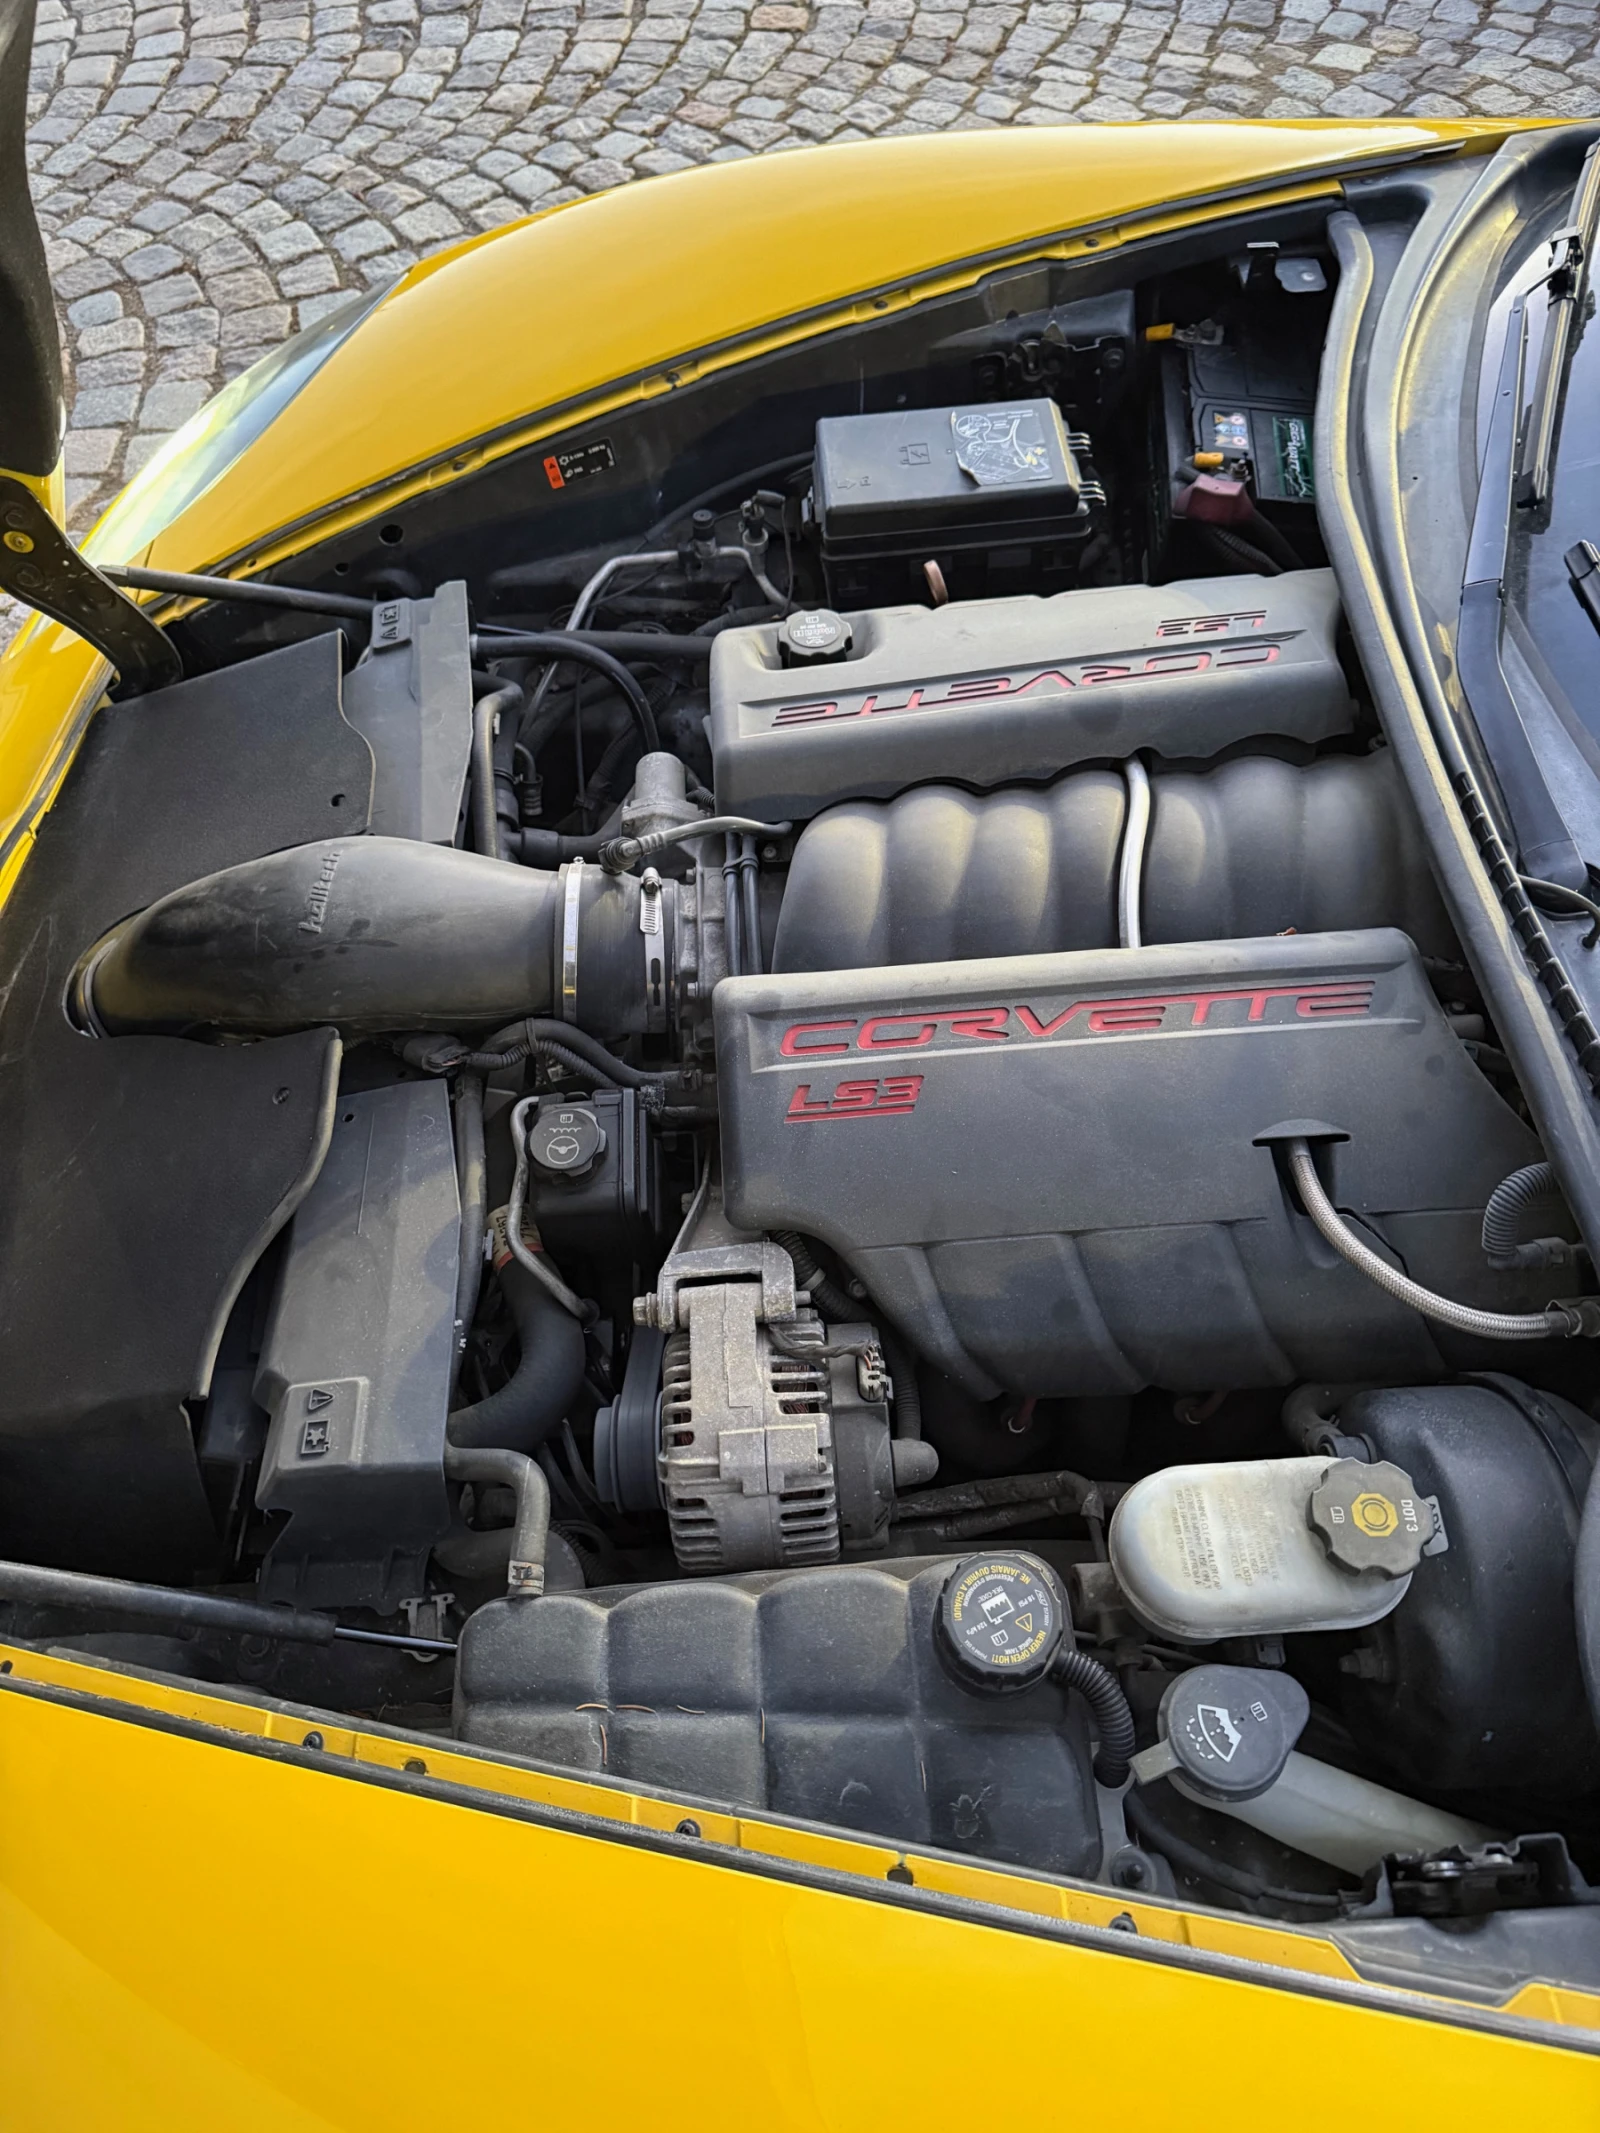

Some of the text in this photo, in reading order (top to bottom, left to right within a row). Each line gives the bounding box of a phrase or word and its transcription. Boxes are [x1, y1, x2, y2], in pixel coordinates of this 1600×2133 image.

[1156, 611, 1267, 637] LS3
[771, 644, 1281, 726] CORVETTE
[780, 980, 1375, 1057] CORVETTE
[785, 1074, 925, 1120] LS3
[1401, 1499, 1419, 1533] DOT 3
[963, 1567, 988, 1584] OUVRIR
[991, 1565, 1020, 1576] JAMAIS
[1020, 1573, 1032, 1584] NE
[954, 1592, 963, 1621] CHAUD!
[1018, 1599, 1028, 1607] PSI
[992, 1630, 1046, 1663] NEVER OPEN HOT!
